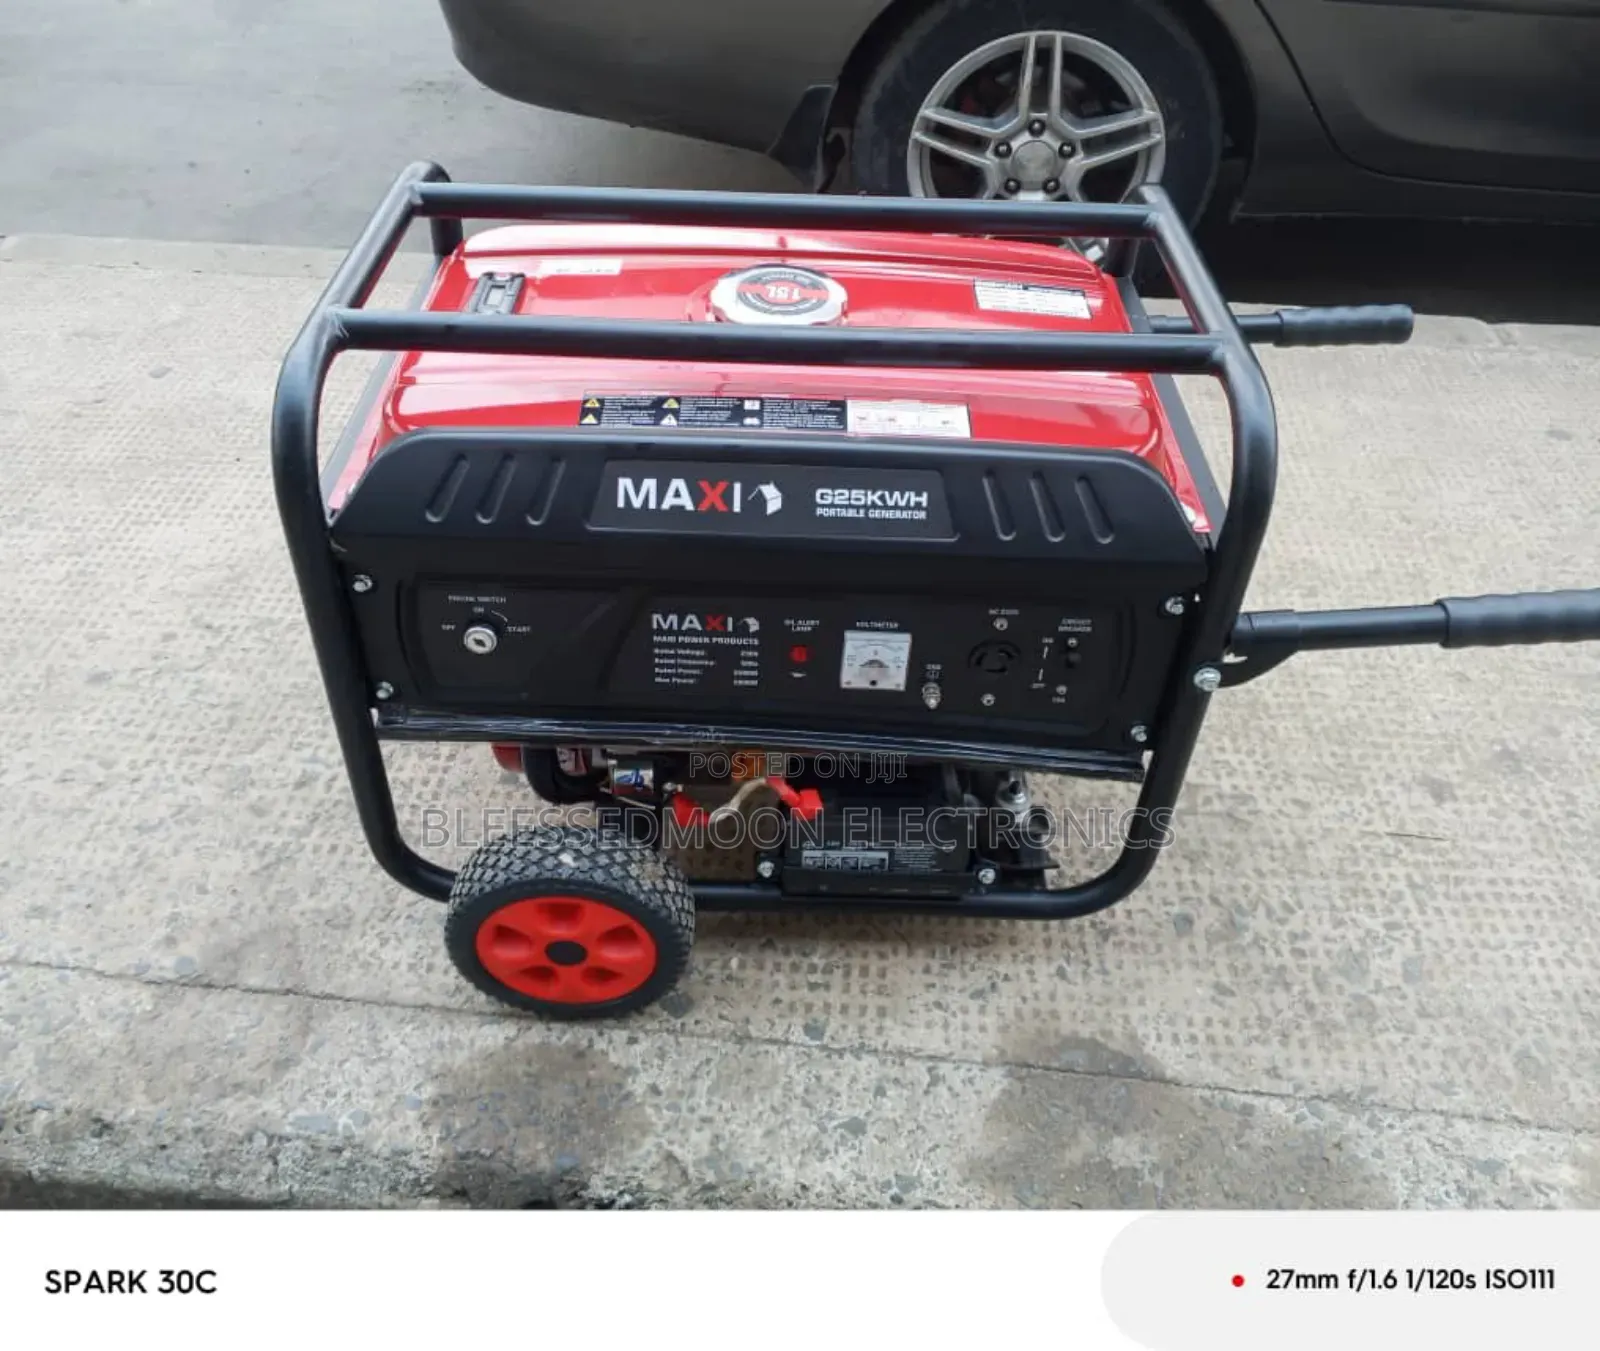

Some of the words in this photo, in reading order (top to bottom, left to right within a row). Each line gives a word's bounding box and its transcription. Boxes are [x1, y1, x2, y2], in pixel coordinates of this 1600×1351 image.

[616, 477, 742, 513] MAXI
[815, 488, 928, 507] G25KWH
[816, 506, 865, 519] PORTABLE
[868, 508, 927, 520] GENERATOR
[652, 613, 733, 633] MAXI
[678, 636, 710, 645] POWER
[712, 637, 760, 646] PRODUCTS
